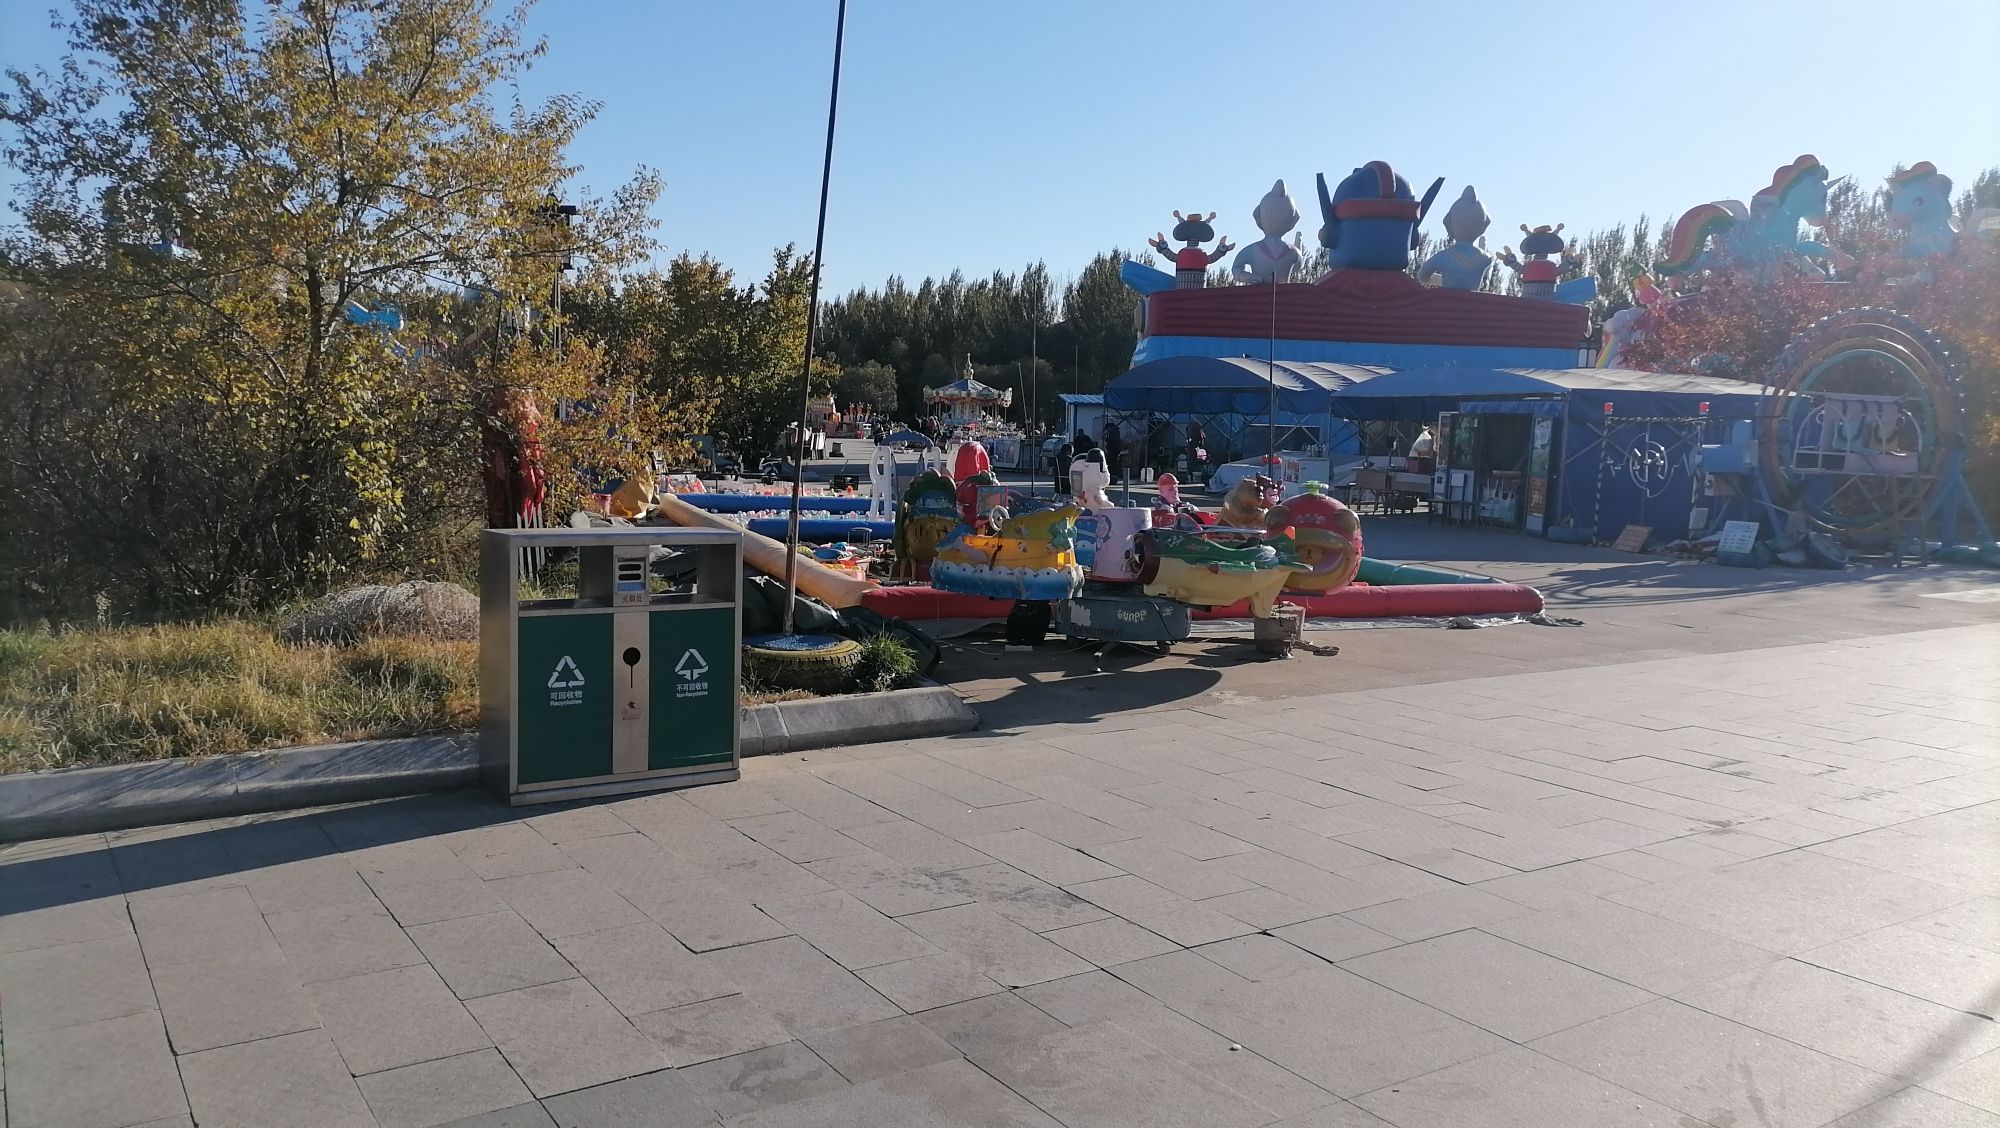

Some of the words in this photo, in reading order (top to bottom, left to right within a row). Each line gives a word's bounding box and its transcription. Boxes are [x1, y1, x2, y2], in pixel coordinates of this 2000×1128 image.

[676, 681, 709, 692] 不可回收物
[549, 689, 583, 701] 可回收物
